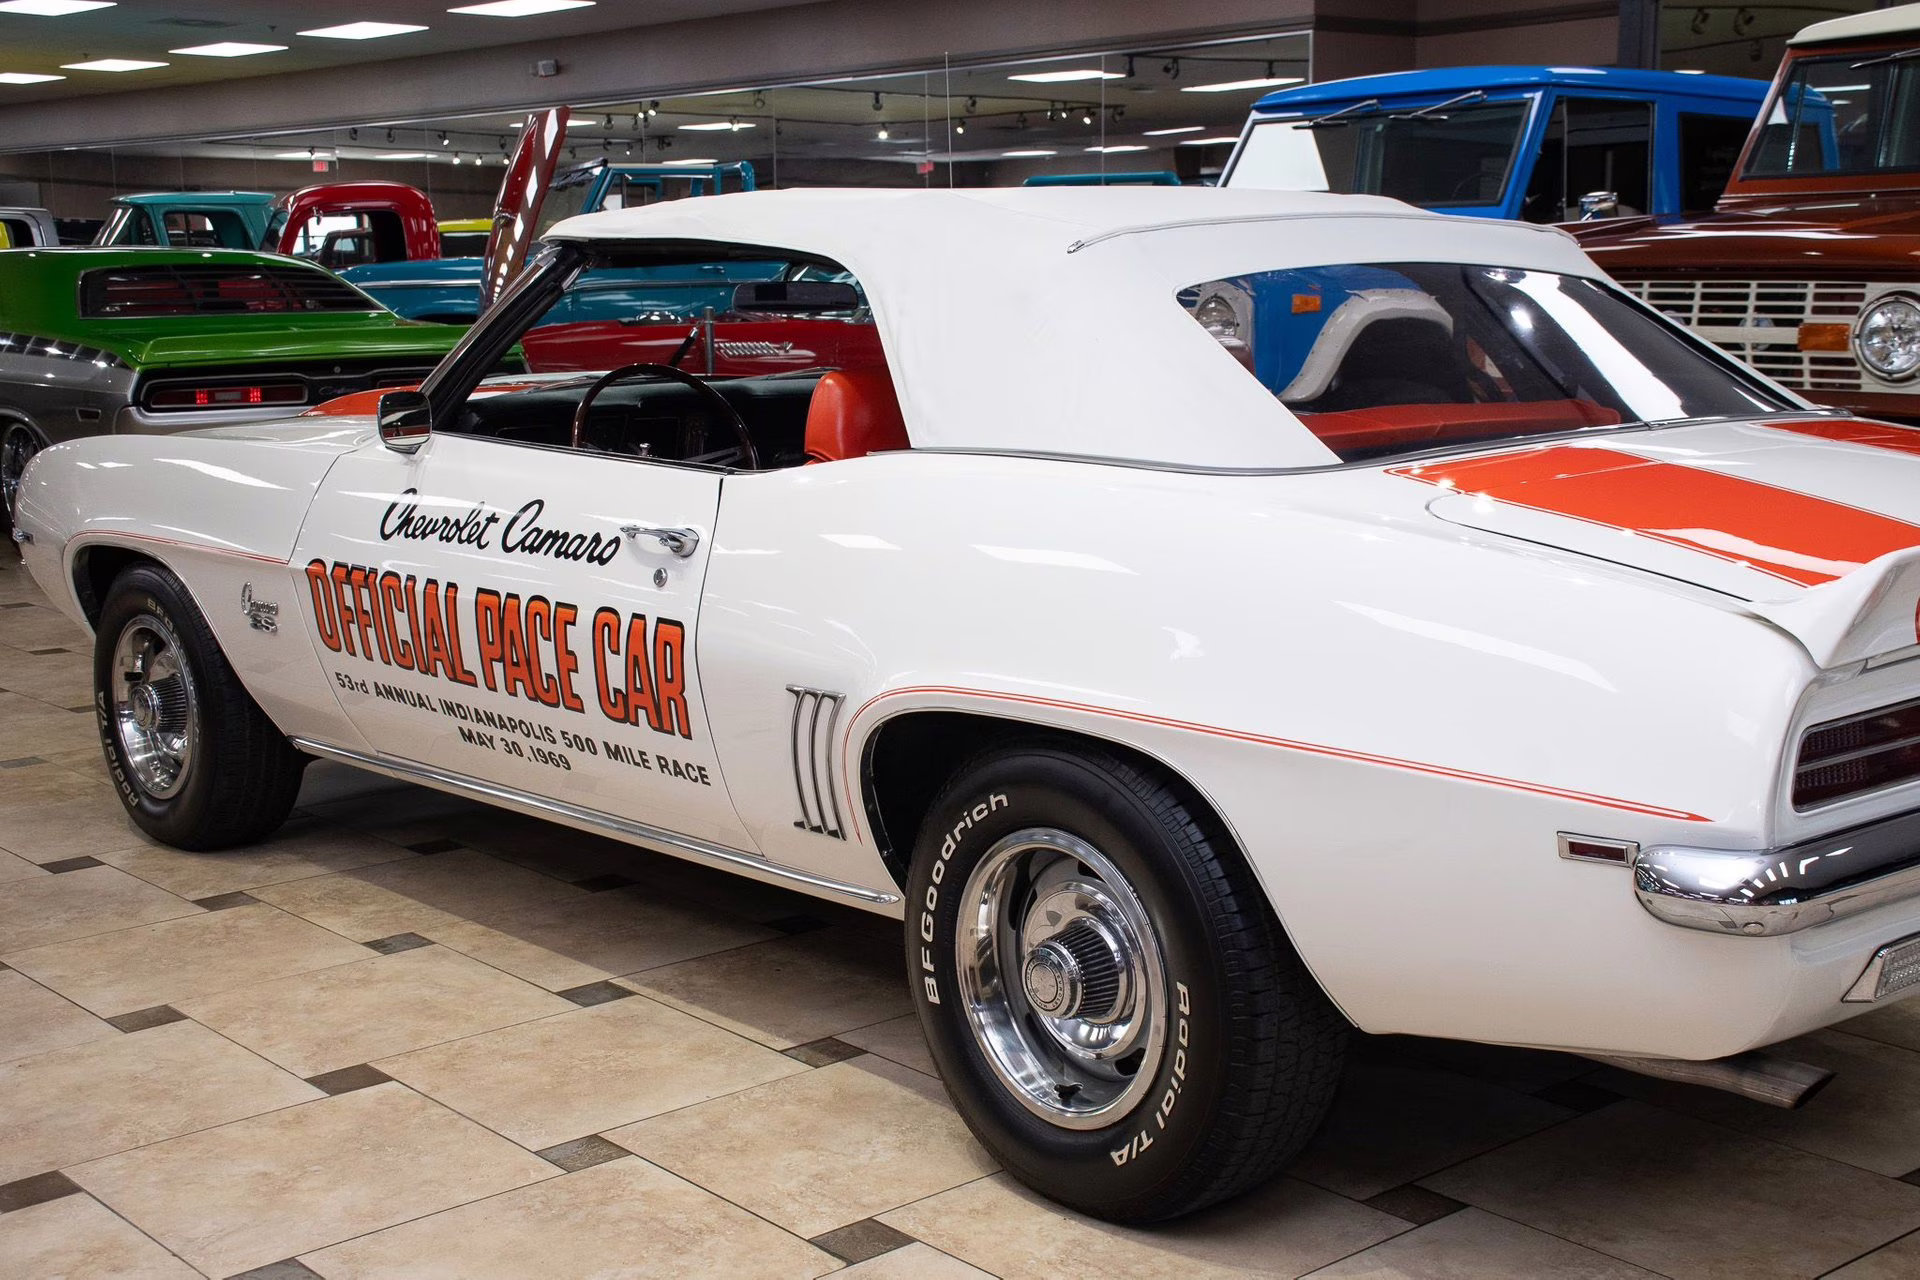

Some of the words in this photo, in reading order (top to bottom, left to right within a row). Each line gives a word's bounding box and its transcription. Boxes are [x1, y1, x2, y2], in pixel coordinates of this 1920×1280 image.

[379, 487, 500, 549] Chevrolet
[501, 499, 621, 566] Camaro
[305, 558, 478, 688] OFFICIAL
[474, 587, 585, 714] PACE
[592, 606, 692, 740] CAR
[335, 672, 369, 694] 53rd
[374, 682, 438, 712] ANNUAL
[438, 698, 557, 744] INDIANAPOLIS
[560, 730, 598, 755] 500
[603, 741, 652, 770] MILE
[656, 755, 711, 786] RACE
[458, 726, 496, 750] MAY
[920, 793, 1009, 1005] BFGoodrich
[1155, 981, 1191, 1131] Radial
[1110, 1128, 1154, 1167] T/A
